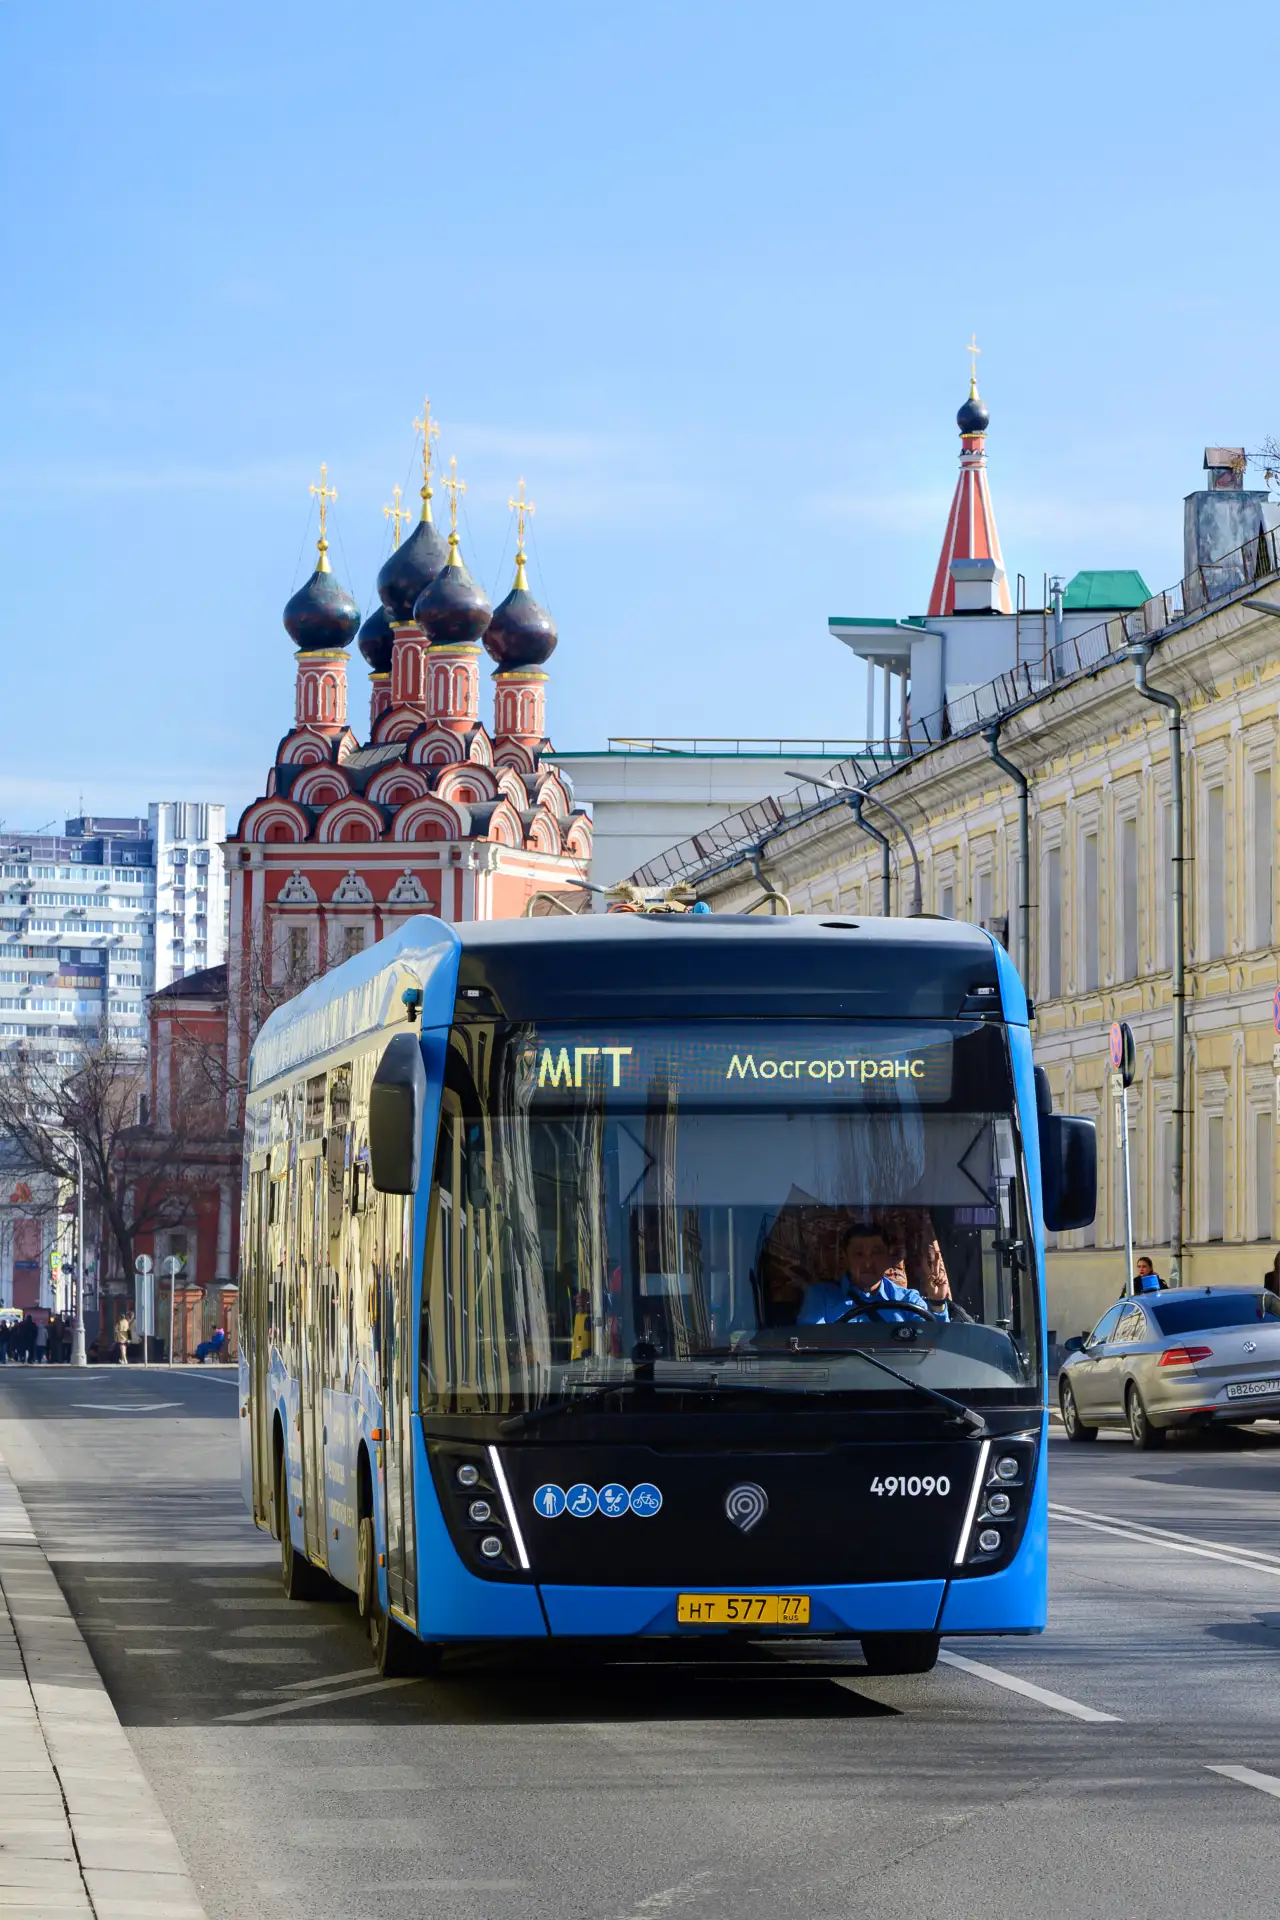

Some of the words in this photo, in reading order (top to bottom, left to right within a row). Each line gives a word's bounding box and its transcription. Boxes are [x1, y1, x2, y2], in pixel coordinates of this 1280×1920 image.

[538, 1047, 633, 1088] МГТ
[726, 1054, 925, 1083] Мосгортранс
[869, 1475, 951, 1497] 491090
[689, 1602, 716, 1619] НТ
[726, 1598, 767, 1620] 577
[780, 1597, 802, 1615] 77
[783, 1614, 799, 1622] RUS
